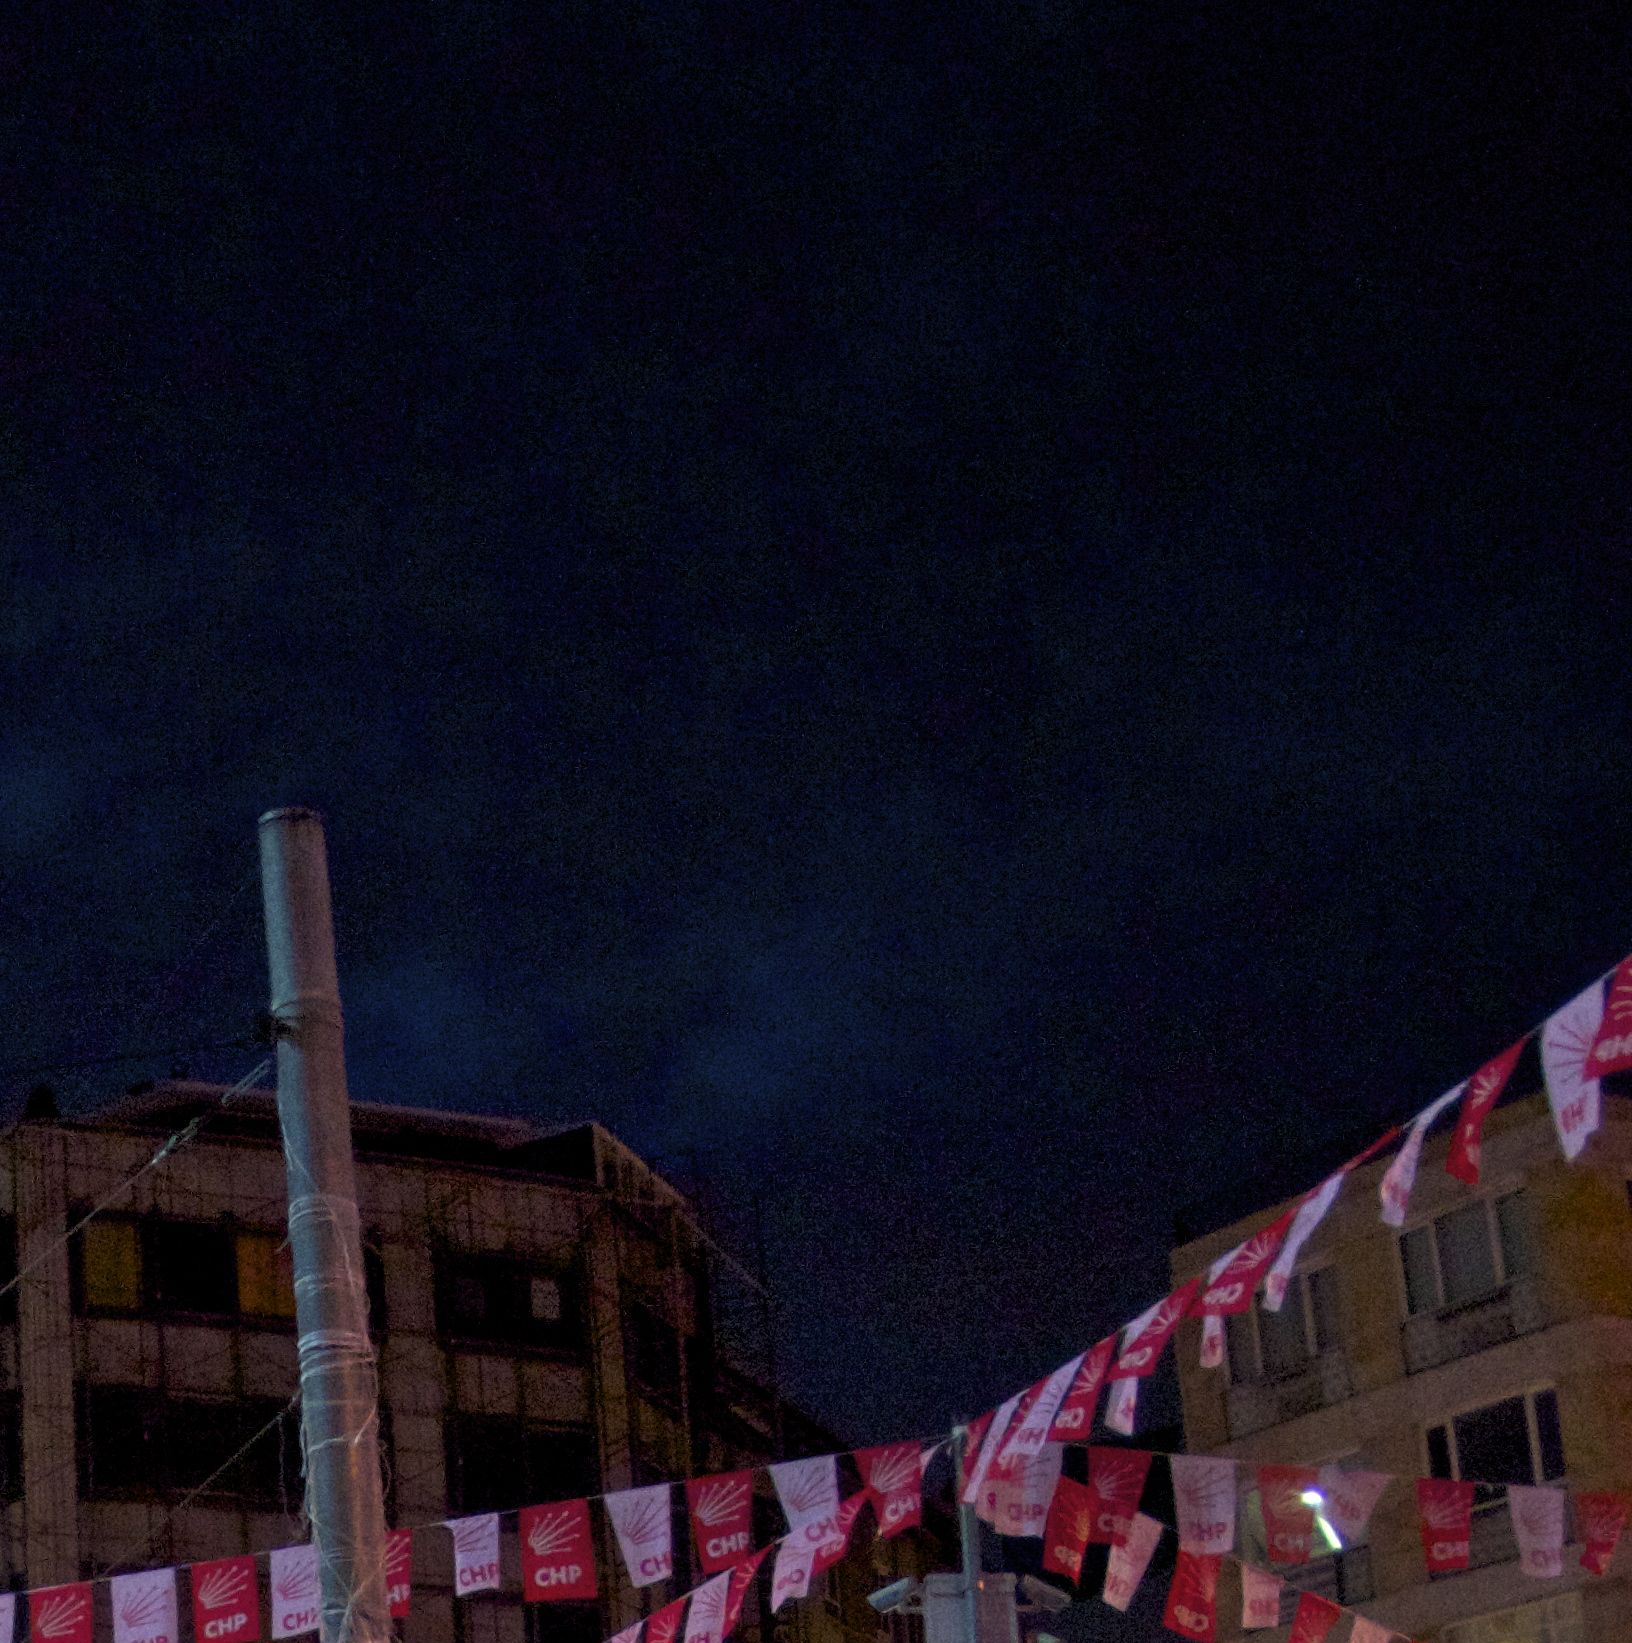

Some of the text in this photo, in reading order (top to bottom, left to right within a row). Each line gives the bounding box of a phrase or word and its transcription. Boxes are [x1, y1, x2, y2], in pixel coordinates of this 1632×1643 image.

[705, 1531, 750, 1558] CHP
[459, 1563, 498, 1587] CHP
[535, 1565, 583, 1587] CHP
[204, 1612, 248, 1640] CHP
